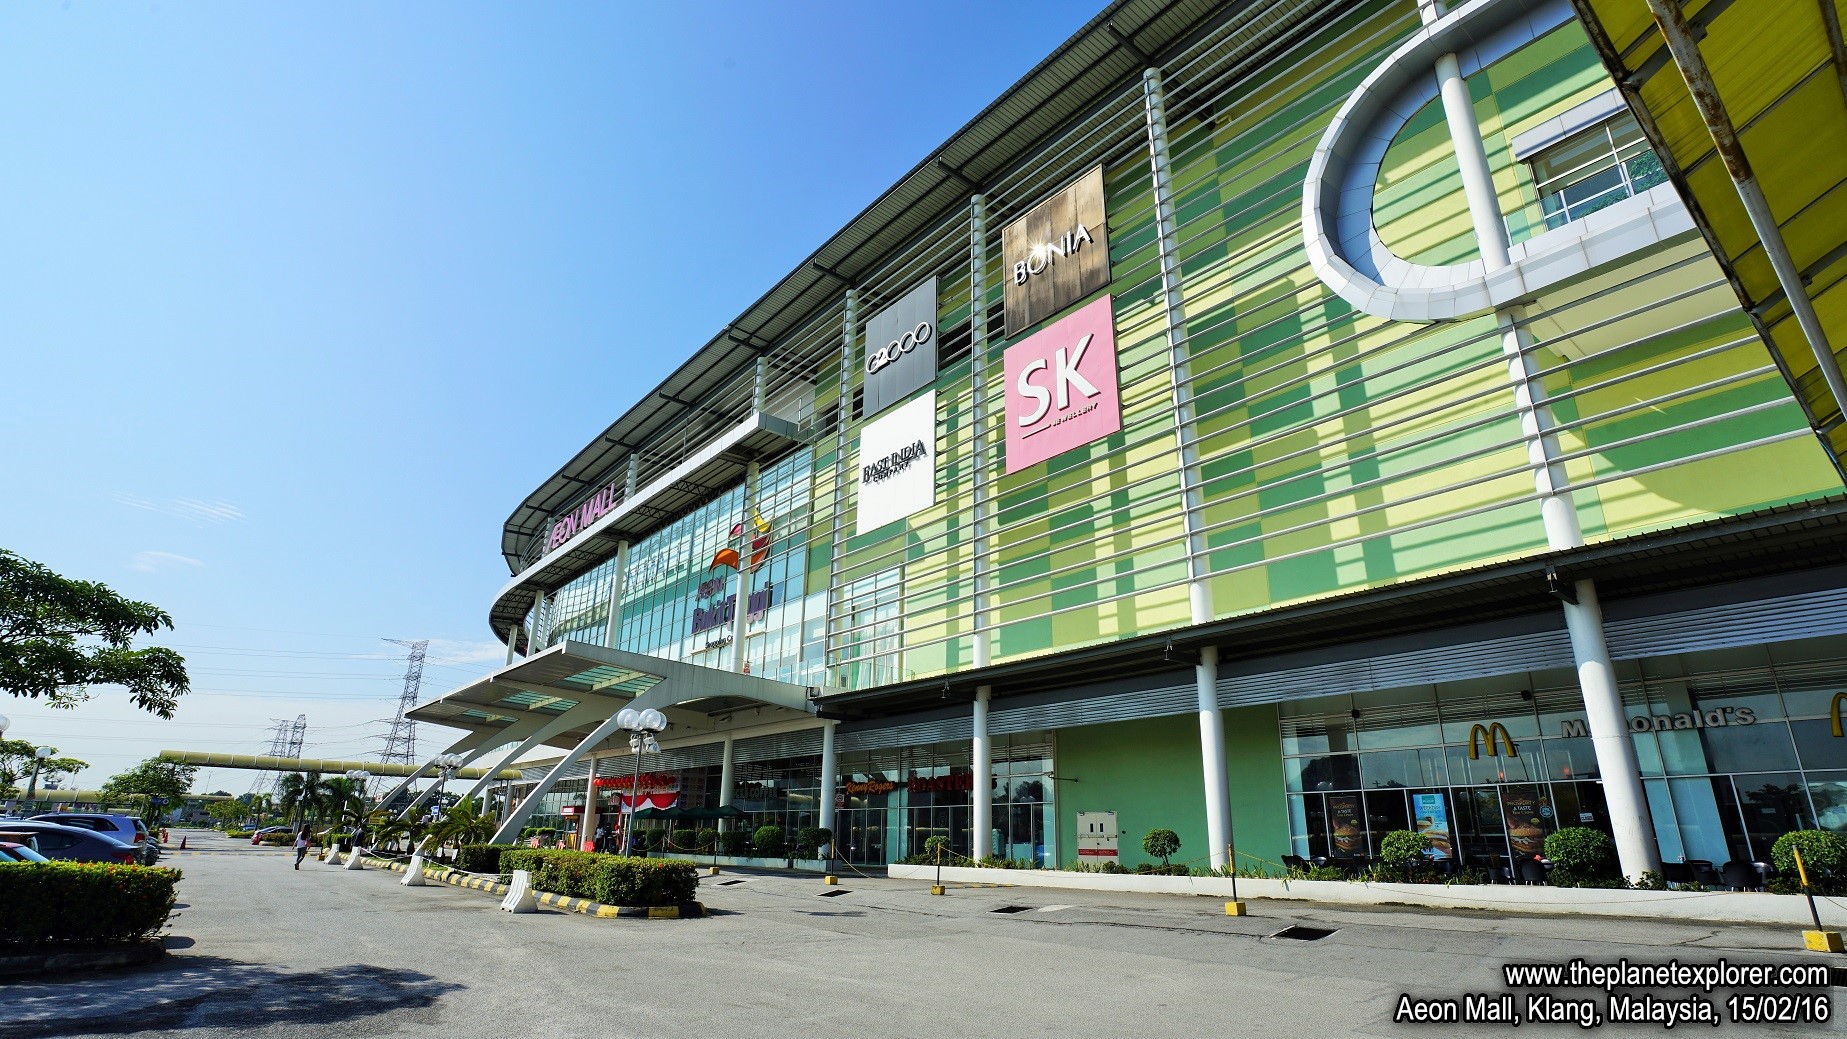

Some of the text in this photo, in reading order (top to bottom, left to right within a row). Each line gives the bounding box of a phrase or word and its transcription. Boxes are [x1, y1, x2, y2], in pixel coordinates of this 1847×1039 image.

[1014, 224, 1092, 285] BONIA
[866, 322, 931, 373] G2000
[1017, 333, 1100, 427] SK
[1053, 403, 1098, 426] JEWELLERY
[862, 440, 927, 483] EAST INDIA
[873, 461, 910, 482] COMPANY
[544, 483, 617, 553] AEON MALL
[691, 581, 770, 634] Bukit Tggi
[1561, 707, 1757, 739] Monald's
[749, 786, 778, 799] COFFEE
[846, 780, 894, 794] Kenny Rogers
